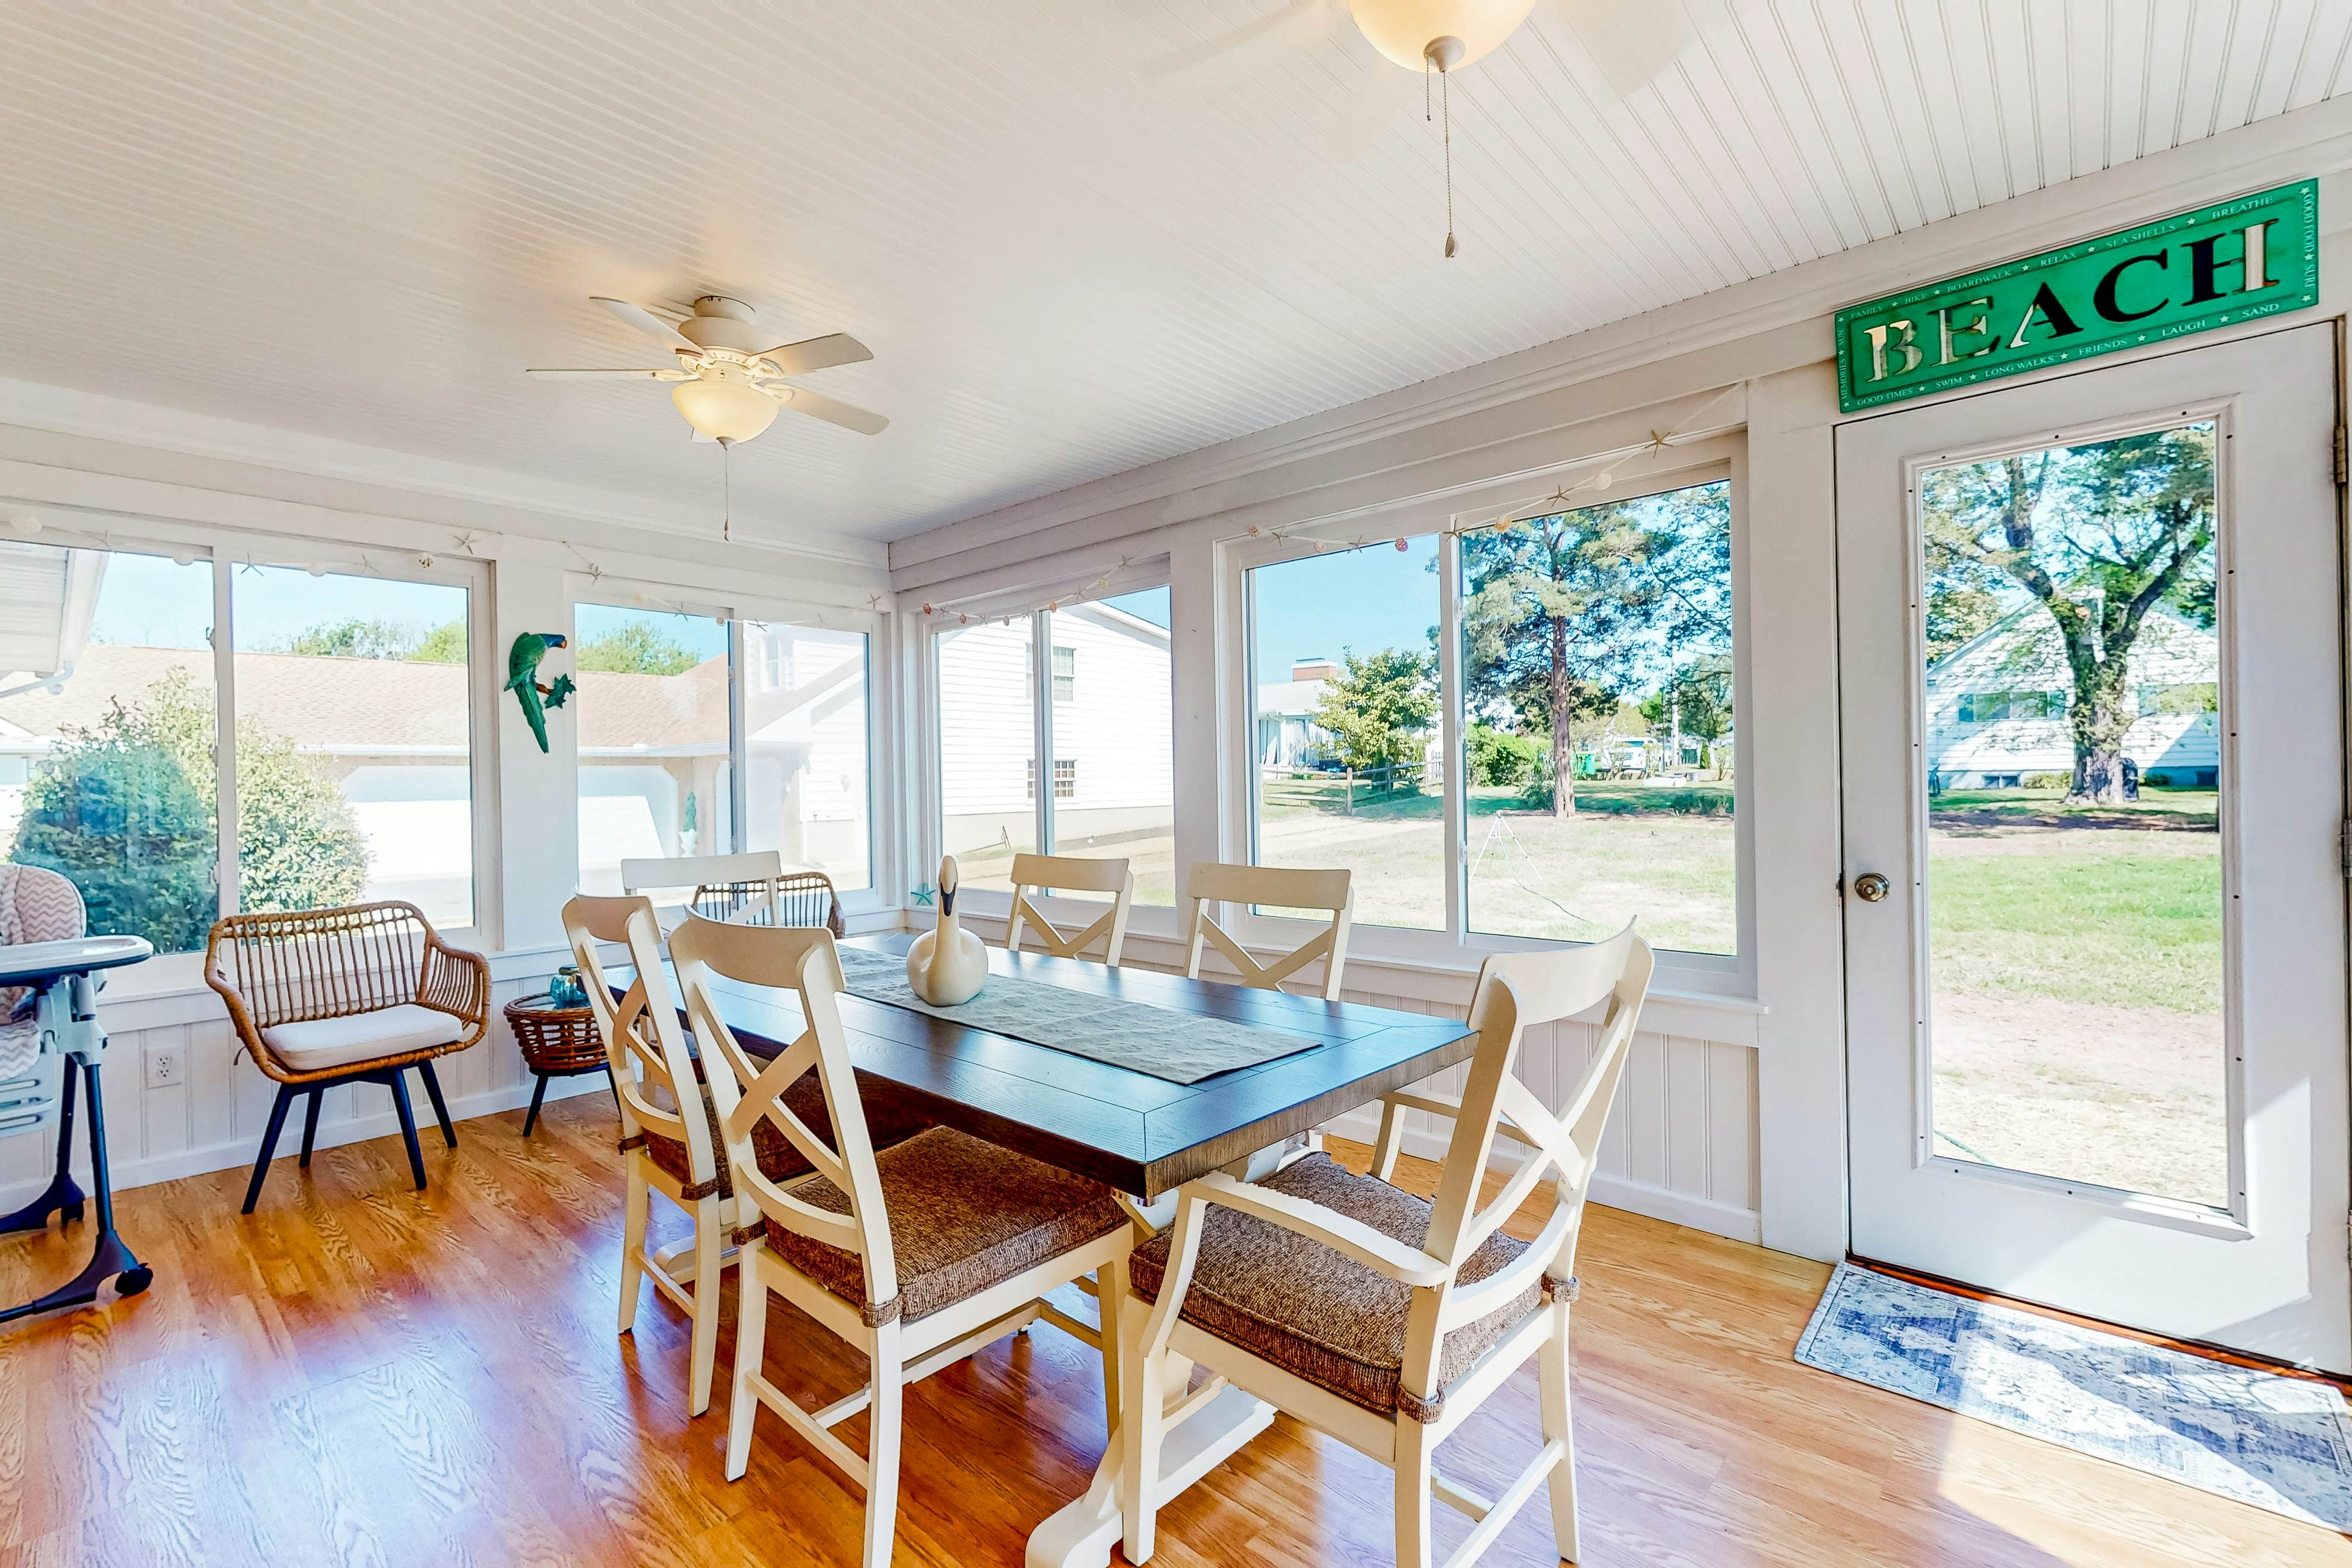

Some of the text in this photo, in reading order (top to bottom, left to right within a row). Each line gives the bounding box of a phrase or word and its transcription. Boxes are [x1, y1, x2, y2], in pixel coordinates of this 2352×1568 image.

[1850, 195, 2274, 320] FAMILY BIKE BOARDWALK RELAX SEA SHELLS BREATHE
[2303, 193, 2316, 288] GOOD FOOD SURF
[1856, 303, 2280, 406] GOOD TIMES SWIM LONG WALKS FRIENDS LAUGH SAND
[1862, 217, 2280, 383] BEACH
